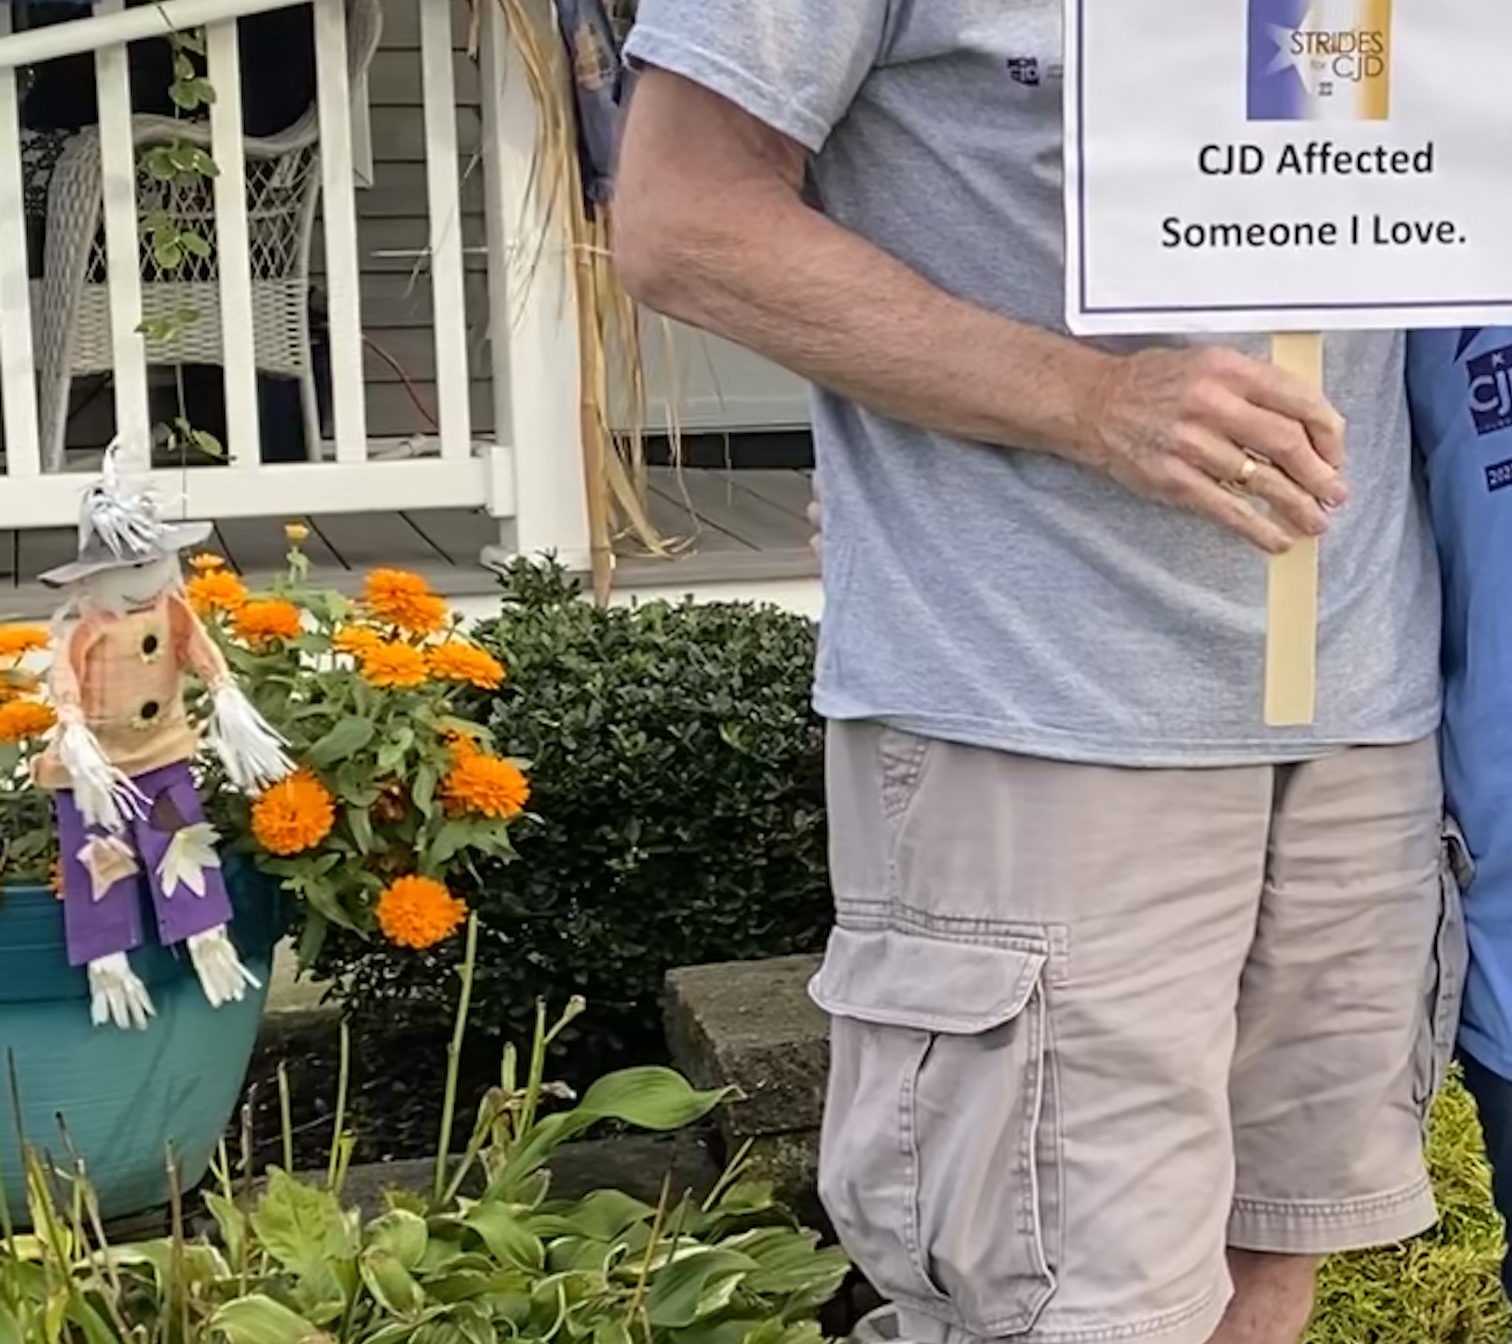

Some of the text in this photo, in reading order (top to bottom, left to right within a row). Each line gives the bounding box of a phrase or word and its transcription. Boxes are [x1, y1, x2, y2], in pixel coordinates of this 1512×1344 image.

[1290, 30, 1384, 55] STRIDES
[1331, 55, 1384, 83] CJD
[1197, 142, 1433, 175] CJD Affected
[1161, 214, 1466, 248] Someone I Love.
